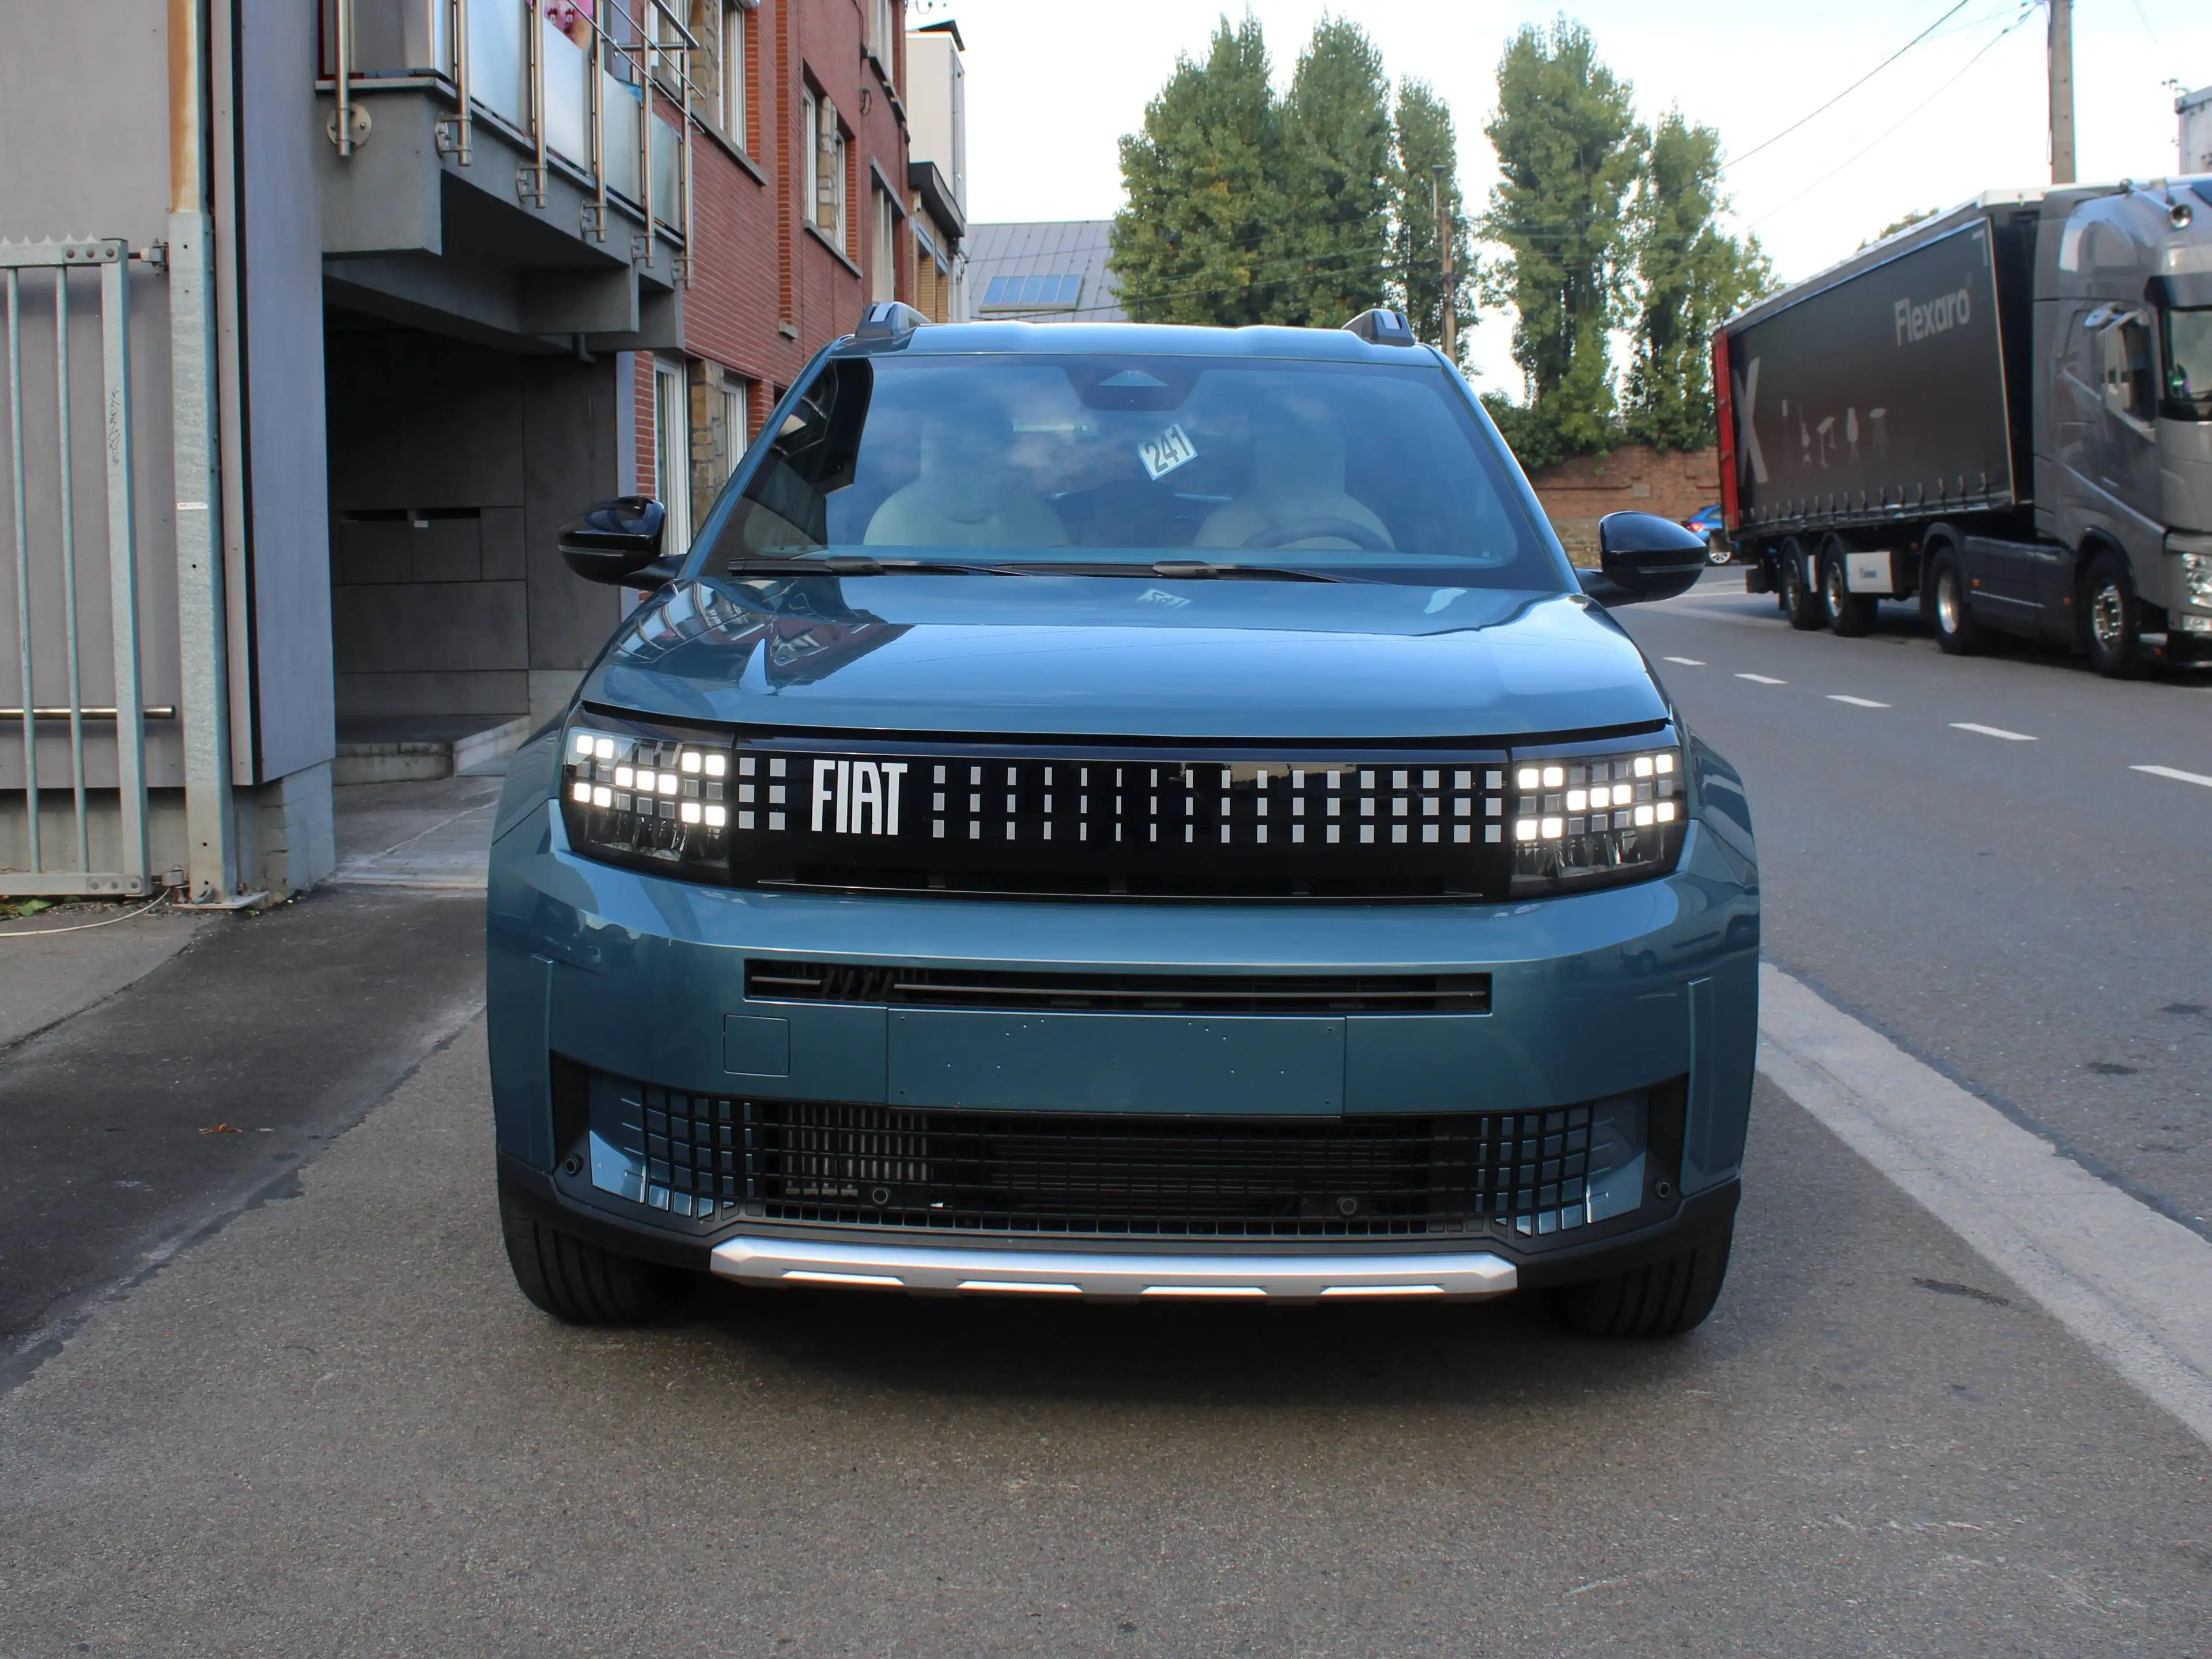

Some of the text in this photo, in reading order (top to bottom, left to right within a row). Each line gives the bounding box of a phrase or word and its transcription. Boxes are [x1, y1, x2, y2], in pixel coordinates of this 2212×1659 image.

[1895, 289, 1971, 347] Flexaro
[1144, 426, 1190, 474] 241
[811, 759, 908, 835] FIAT
